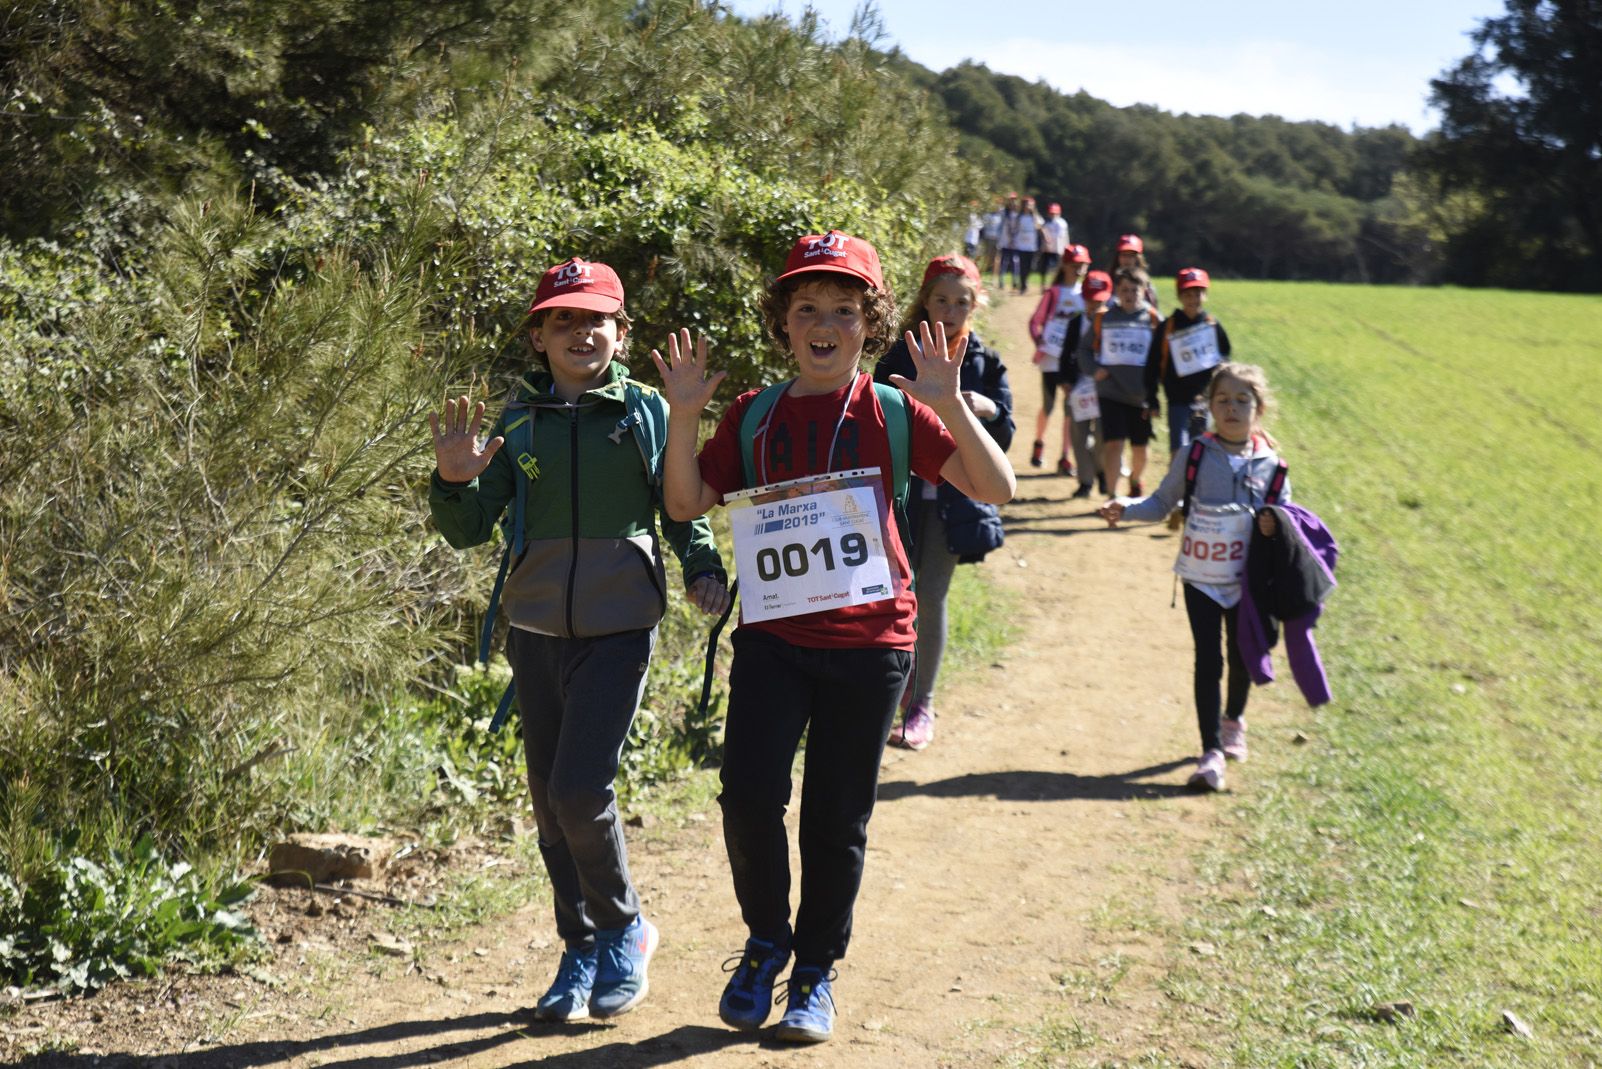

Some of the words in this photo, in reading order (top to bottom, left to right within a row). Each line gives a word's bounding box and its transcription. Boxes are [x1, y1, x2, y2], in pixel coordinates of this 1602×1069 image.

[808, 233, 849, 250] TOT
[803, 249, 821, 258] Sant
[557, 262, 593, 280] TOT
[553, 278, 570, 287] Sant
[770, 420, 859, 472] AIR
[777, 501, 817, 517] Marxa
[756, 532, 869, 582] 0019
[1183, 535, 1244, 562] 0022
